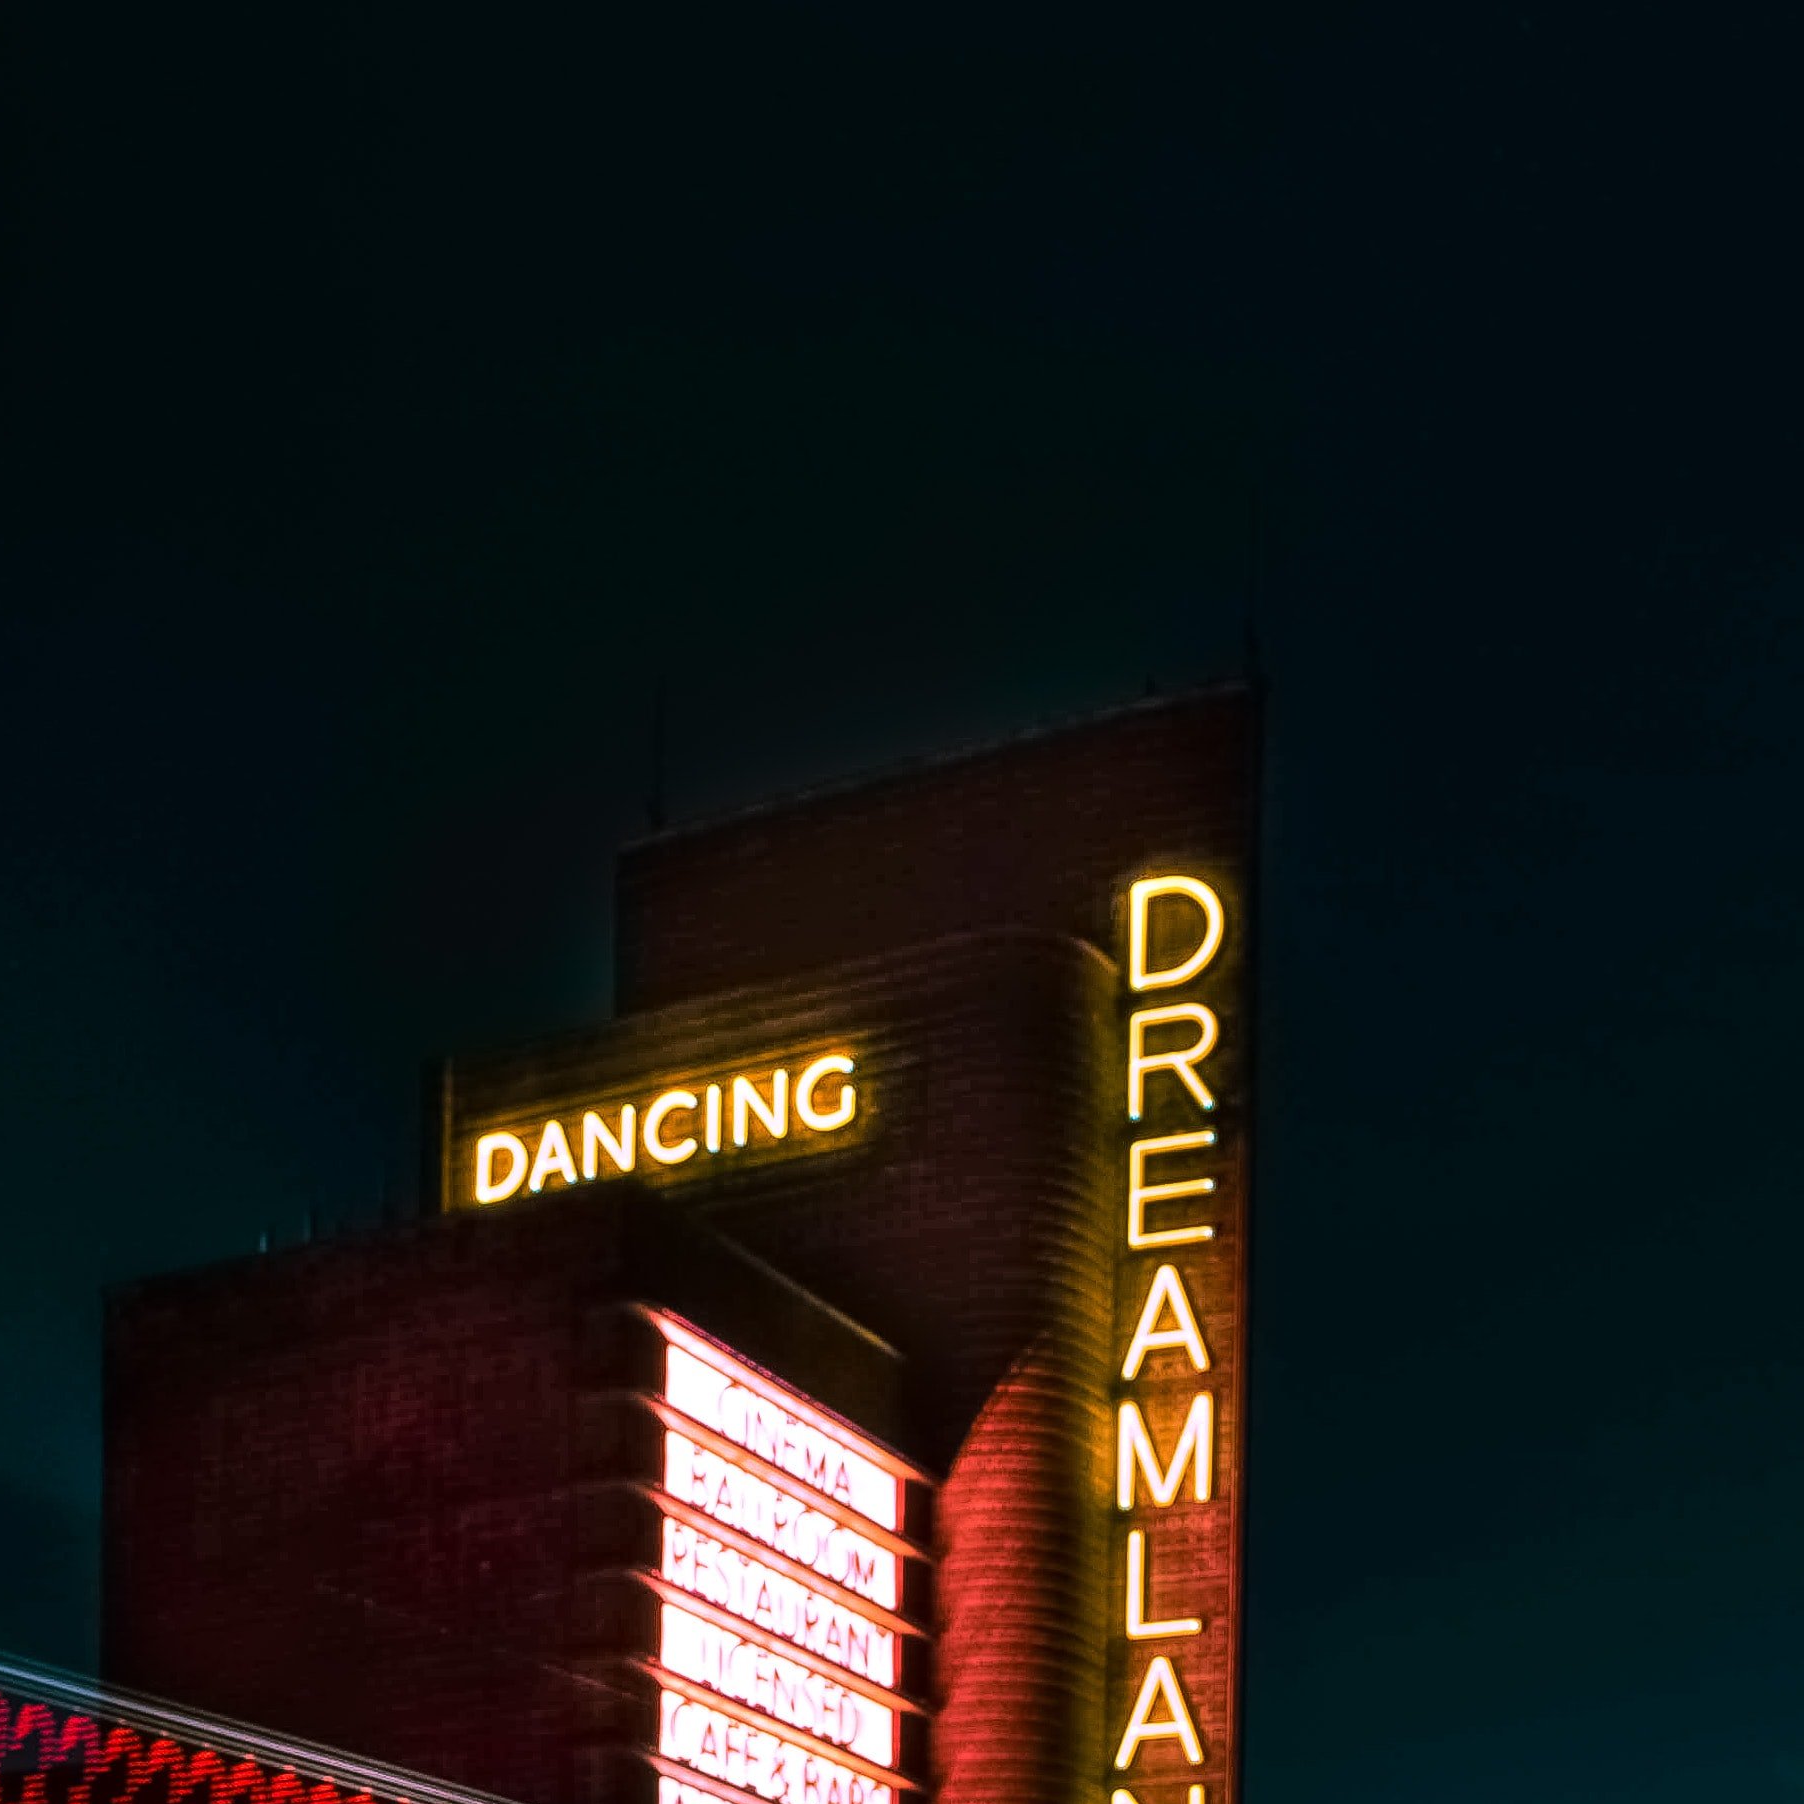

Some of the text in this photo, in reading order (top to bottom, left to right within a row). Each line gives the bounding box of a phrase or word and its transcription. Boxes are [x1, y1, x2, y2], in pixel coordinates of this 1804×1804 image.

[474, 1053, 857, 1205] DANCING
[717, 1380, 853, 1507] CINEMA
[690, 1444, 879, 1599] BALLROOM
[670, 1699, 760, 1790] CAFE
